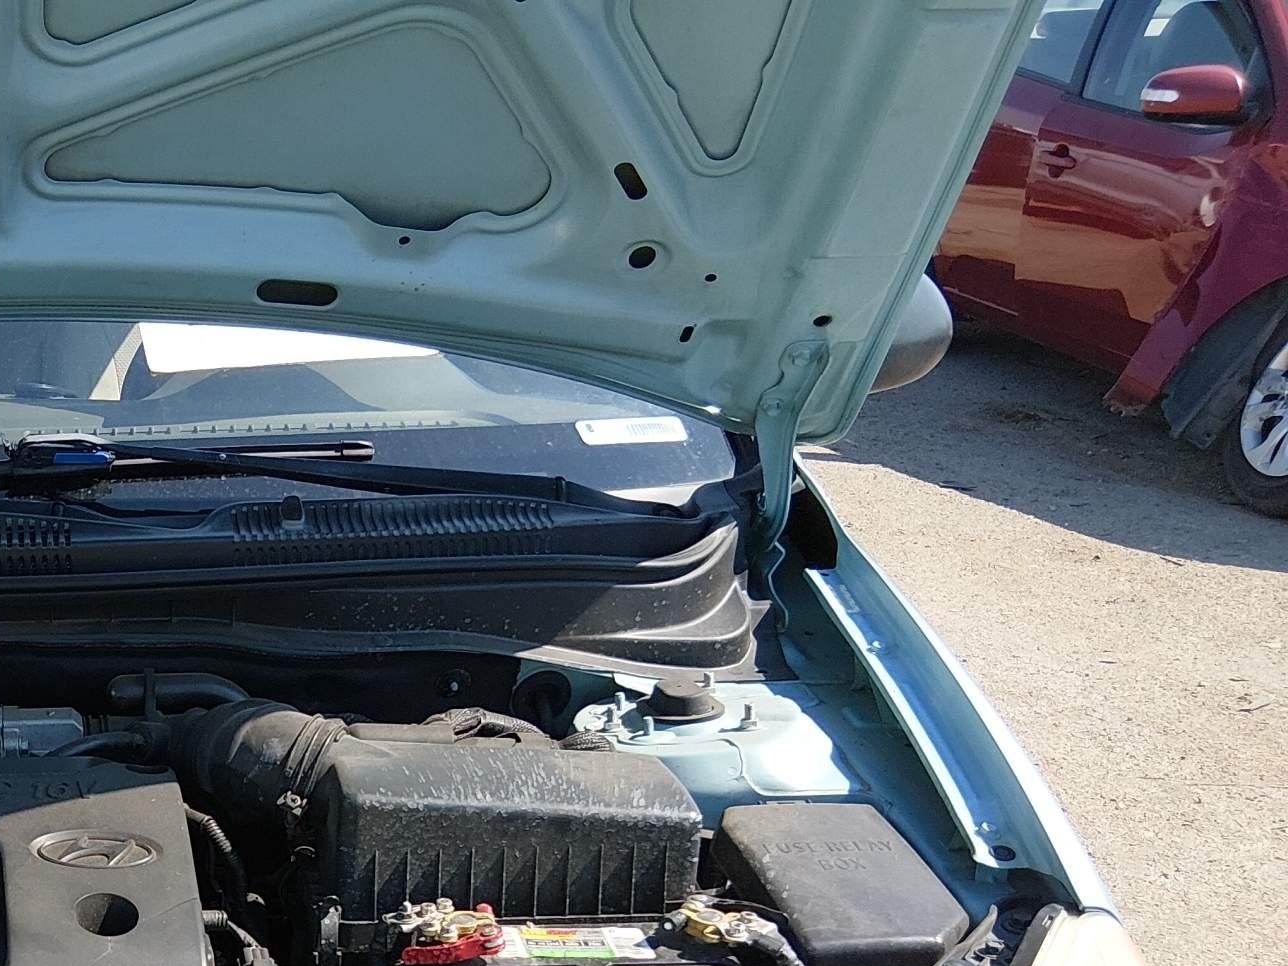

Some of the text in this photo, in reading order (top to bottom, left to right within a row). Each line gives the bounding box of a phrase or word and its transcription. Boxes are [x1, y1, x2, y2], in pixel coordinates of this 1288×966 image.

[31, 779, 98, 800] 16V
[761, 840, 894, 854] FUSE RELAY
[817, 857, 868, 872] BOX
